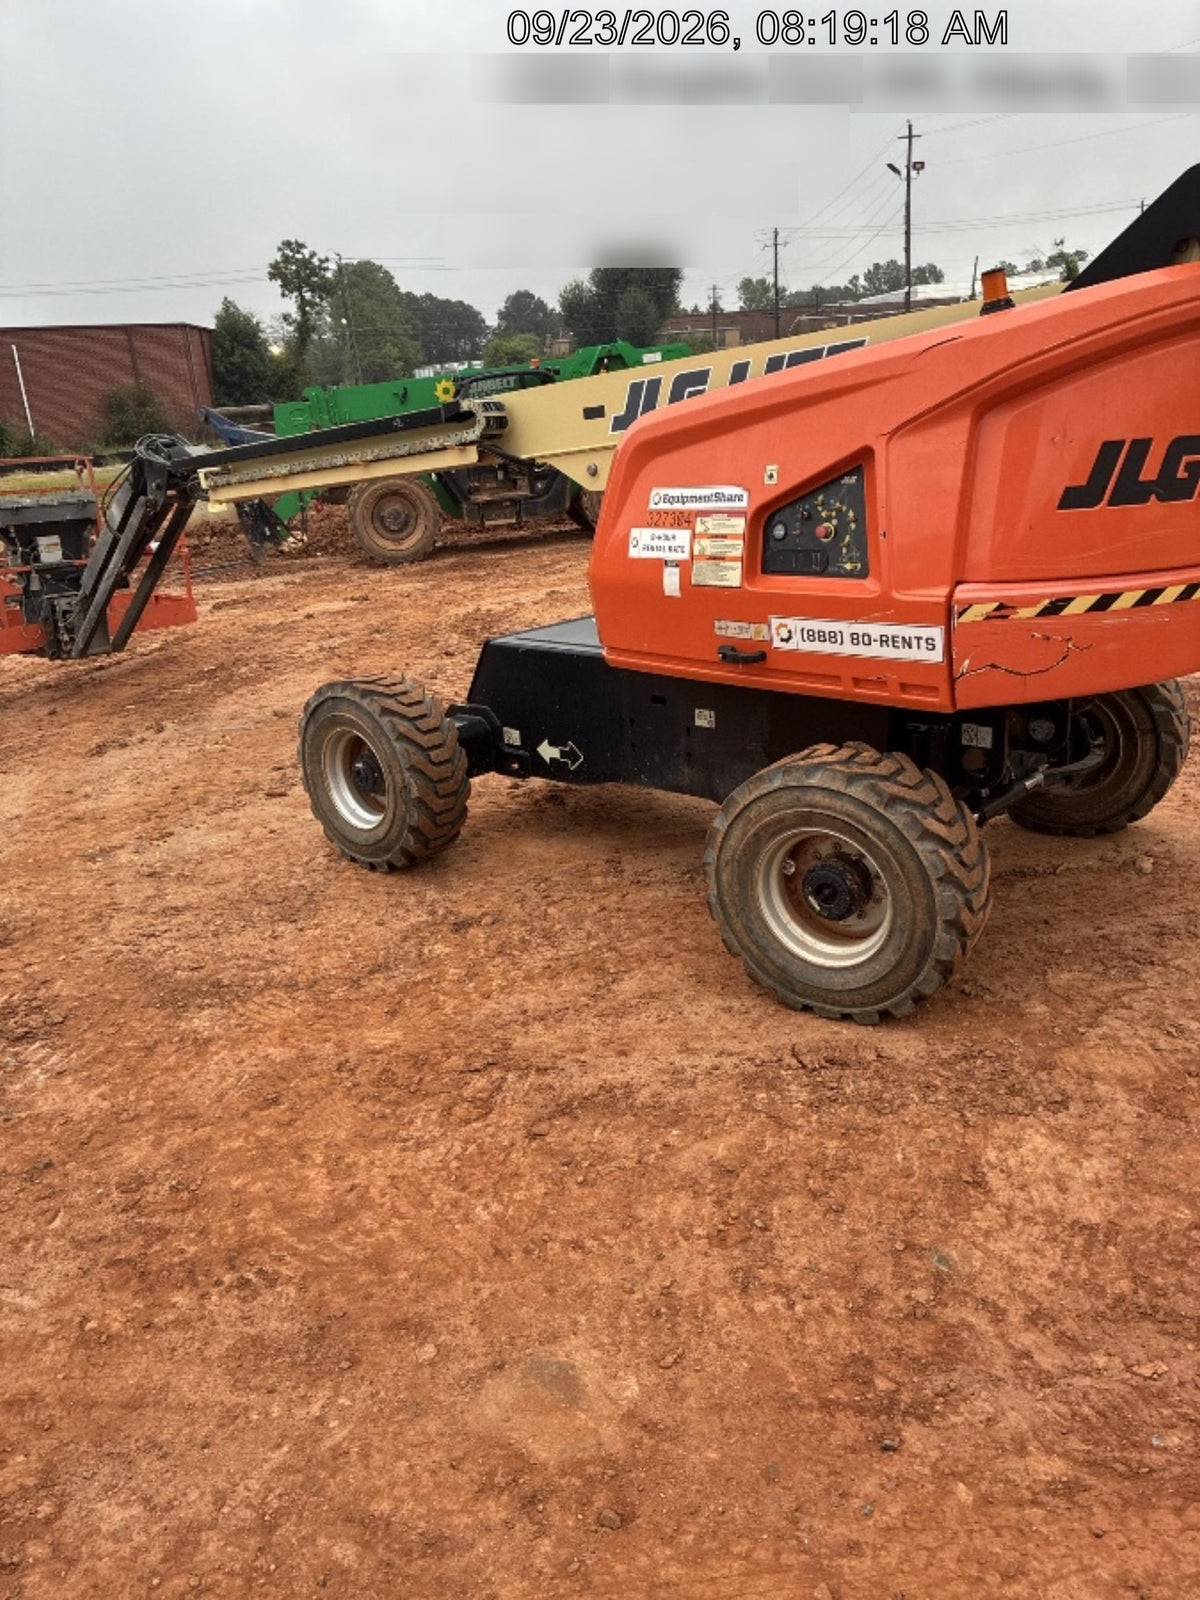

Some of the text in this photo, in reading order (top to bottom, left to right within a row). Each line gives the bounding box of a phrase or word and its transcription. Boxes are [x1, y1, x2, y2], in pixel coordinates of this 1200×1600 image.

[1057, 434, 1200, 511] JLG
[662, 491, 744, 506] EquipmentShare
[800, 627, 937, 652] (888) 80-RENTS
